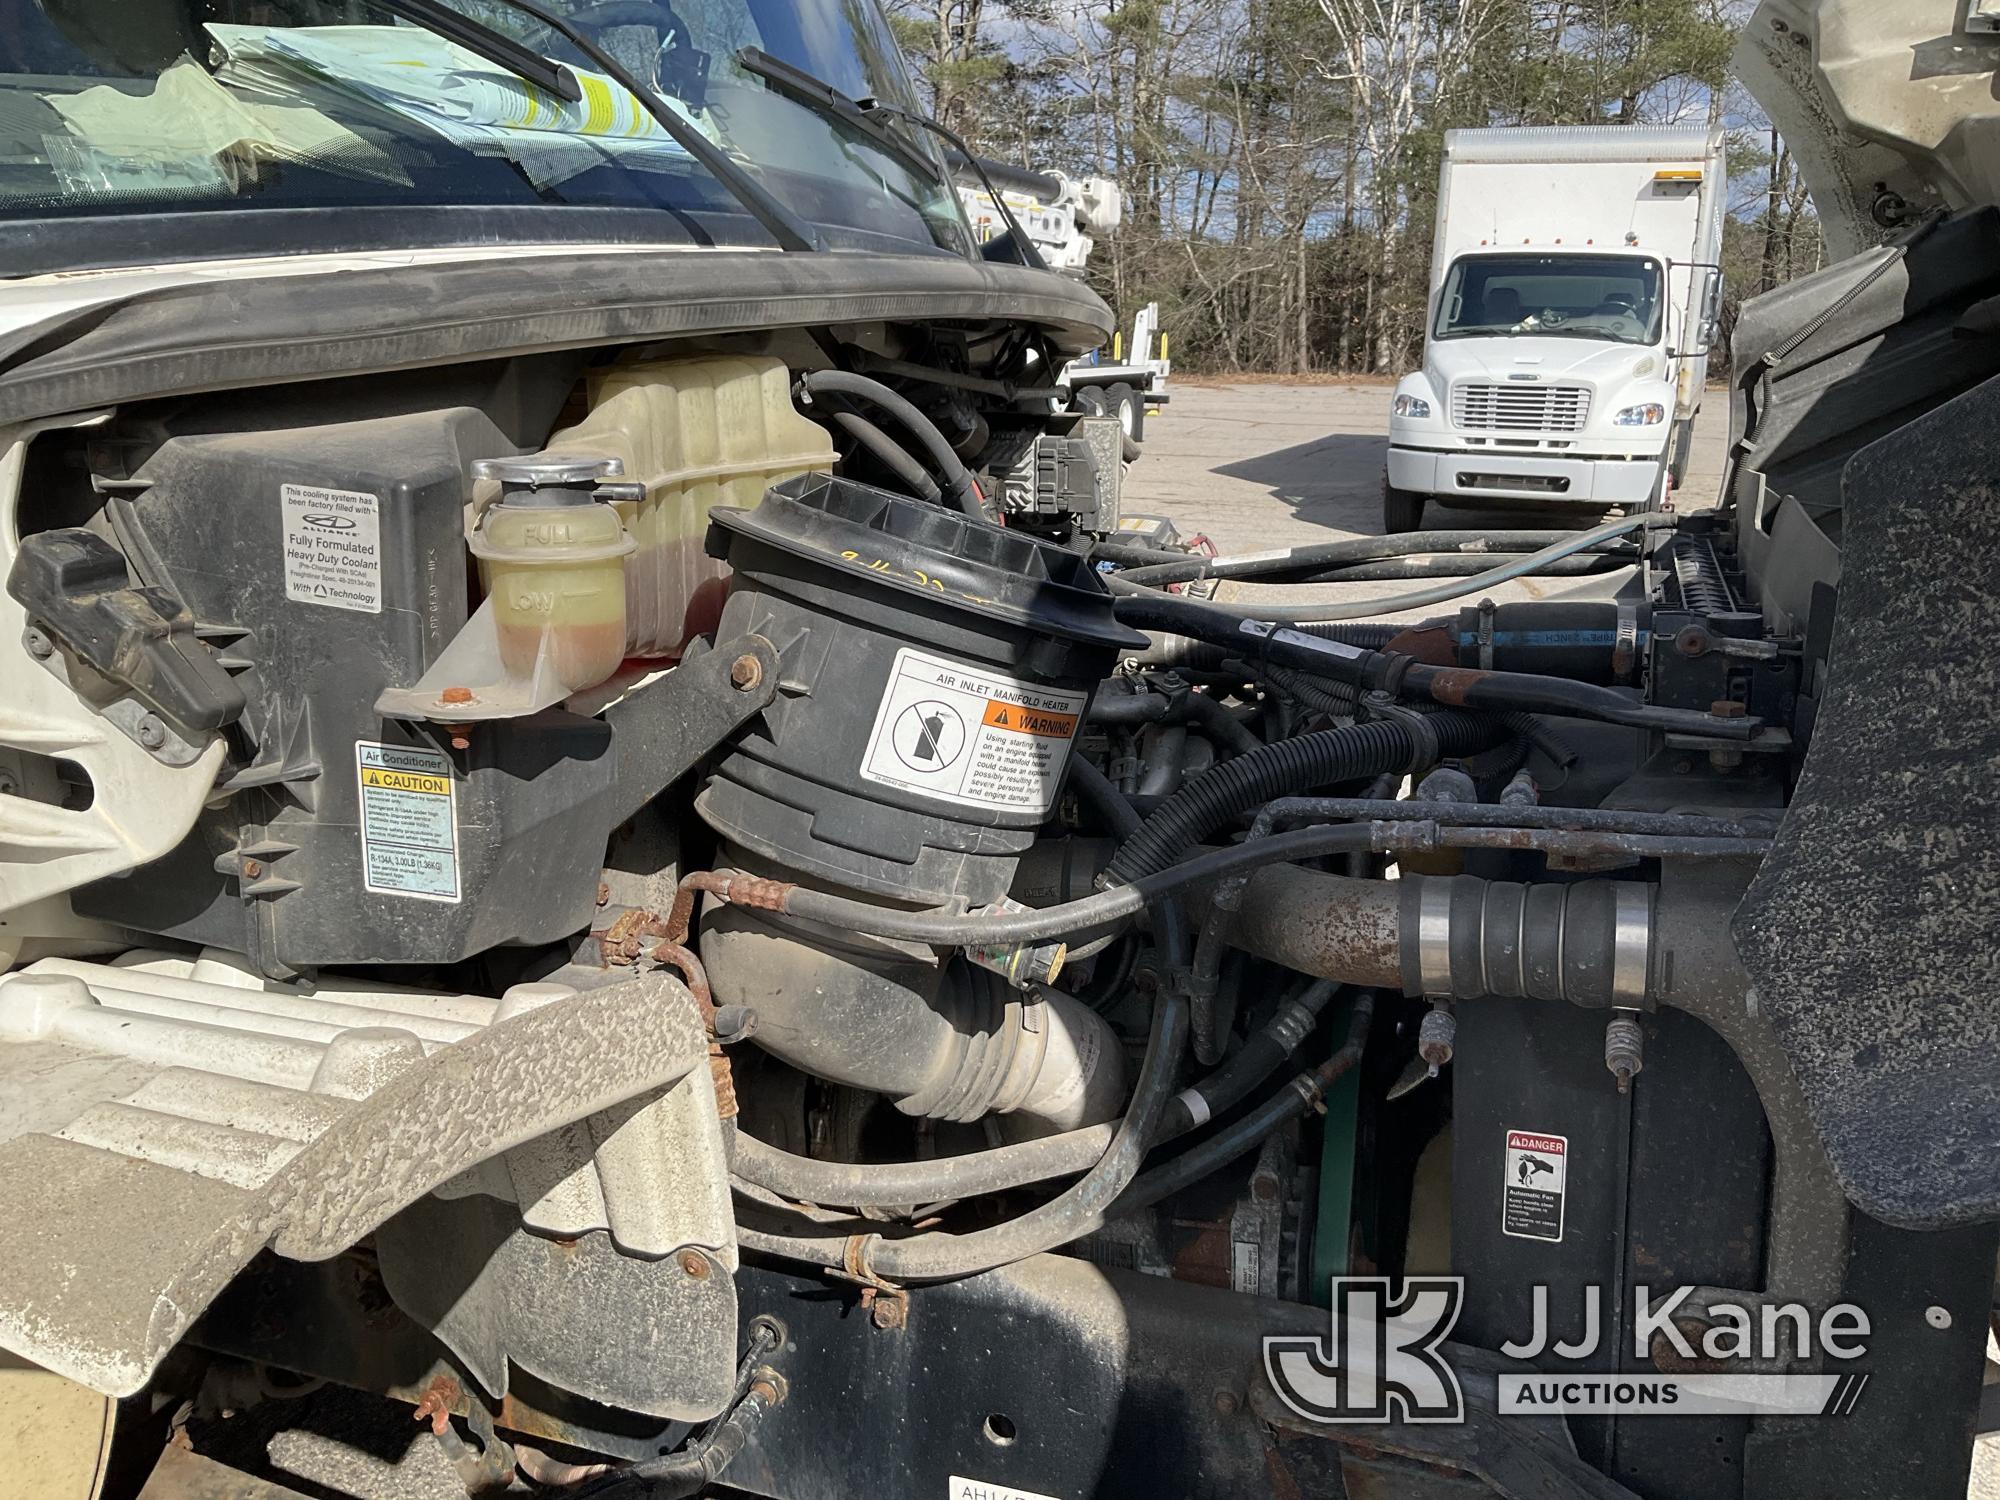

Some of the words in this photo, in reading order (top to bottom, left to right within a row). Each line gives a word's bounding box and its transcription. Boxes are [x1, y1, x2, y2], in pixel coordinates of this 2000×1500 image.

[286, 487, 300, 496] This
[303, 490, 329, 501] cooling
[331, 495, 356, 504] system
[359, 497, 372, 505] has
[288, 498, 306, 506] been
[308, 501, 333, 511] factory
[336, 504, 353, 512] filled
[302, 526, 358, 537] ALLIANCE
[289, 534, 313, 549] Fully
[317, 537, 374, 555] Formulated
[287, 549, 315, 563] Heavy
[318, 553, 339, 565] Duty
[341, 556, 378, 570] Coolant
[336, 567, 349, 575] With
[293, 583, 311, 593] With
[329, 588, 375, 603] Technology
[936, 673, 956, 687] AIR
[959, 679, 990, 695] INLET
[993, 689, 1039, 706] MANIFOLD
[1042, 699, 1070, 712] HEATER
[1019, 715, 1070, 734] WARNING
[986, 733, 1006, 744] Using
[1010, 740, 1033, 749] starting
[365, 751, 379, 761] Air
[382, 753, 442, 769] Conditioner
[980, 752, 994, 760] with
[1004, 757, 1029, 766] manifold
[1006, 748, 1026, 757] engine
[1029, 752, 1052, 760] equipped
[977, 761, 996, 770] could
[383, 774, 443, 792] CAUTION
[974, 770, 1004, 782] possibly
[1007, 776, 1032, 786] resulting
[971, 780, 994, 788] severe
[997, 784, 1024, 793] personal
[985, 791, 1006, 799] engine
[370, 854, 394, 866] R-134A,
[395, 857, 416, 868] 3.00LB
[1522, 1139, 1563, 1152] DANGER
[1509, 1189, 1540, 1199] Automatic
